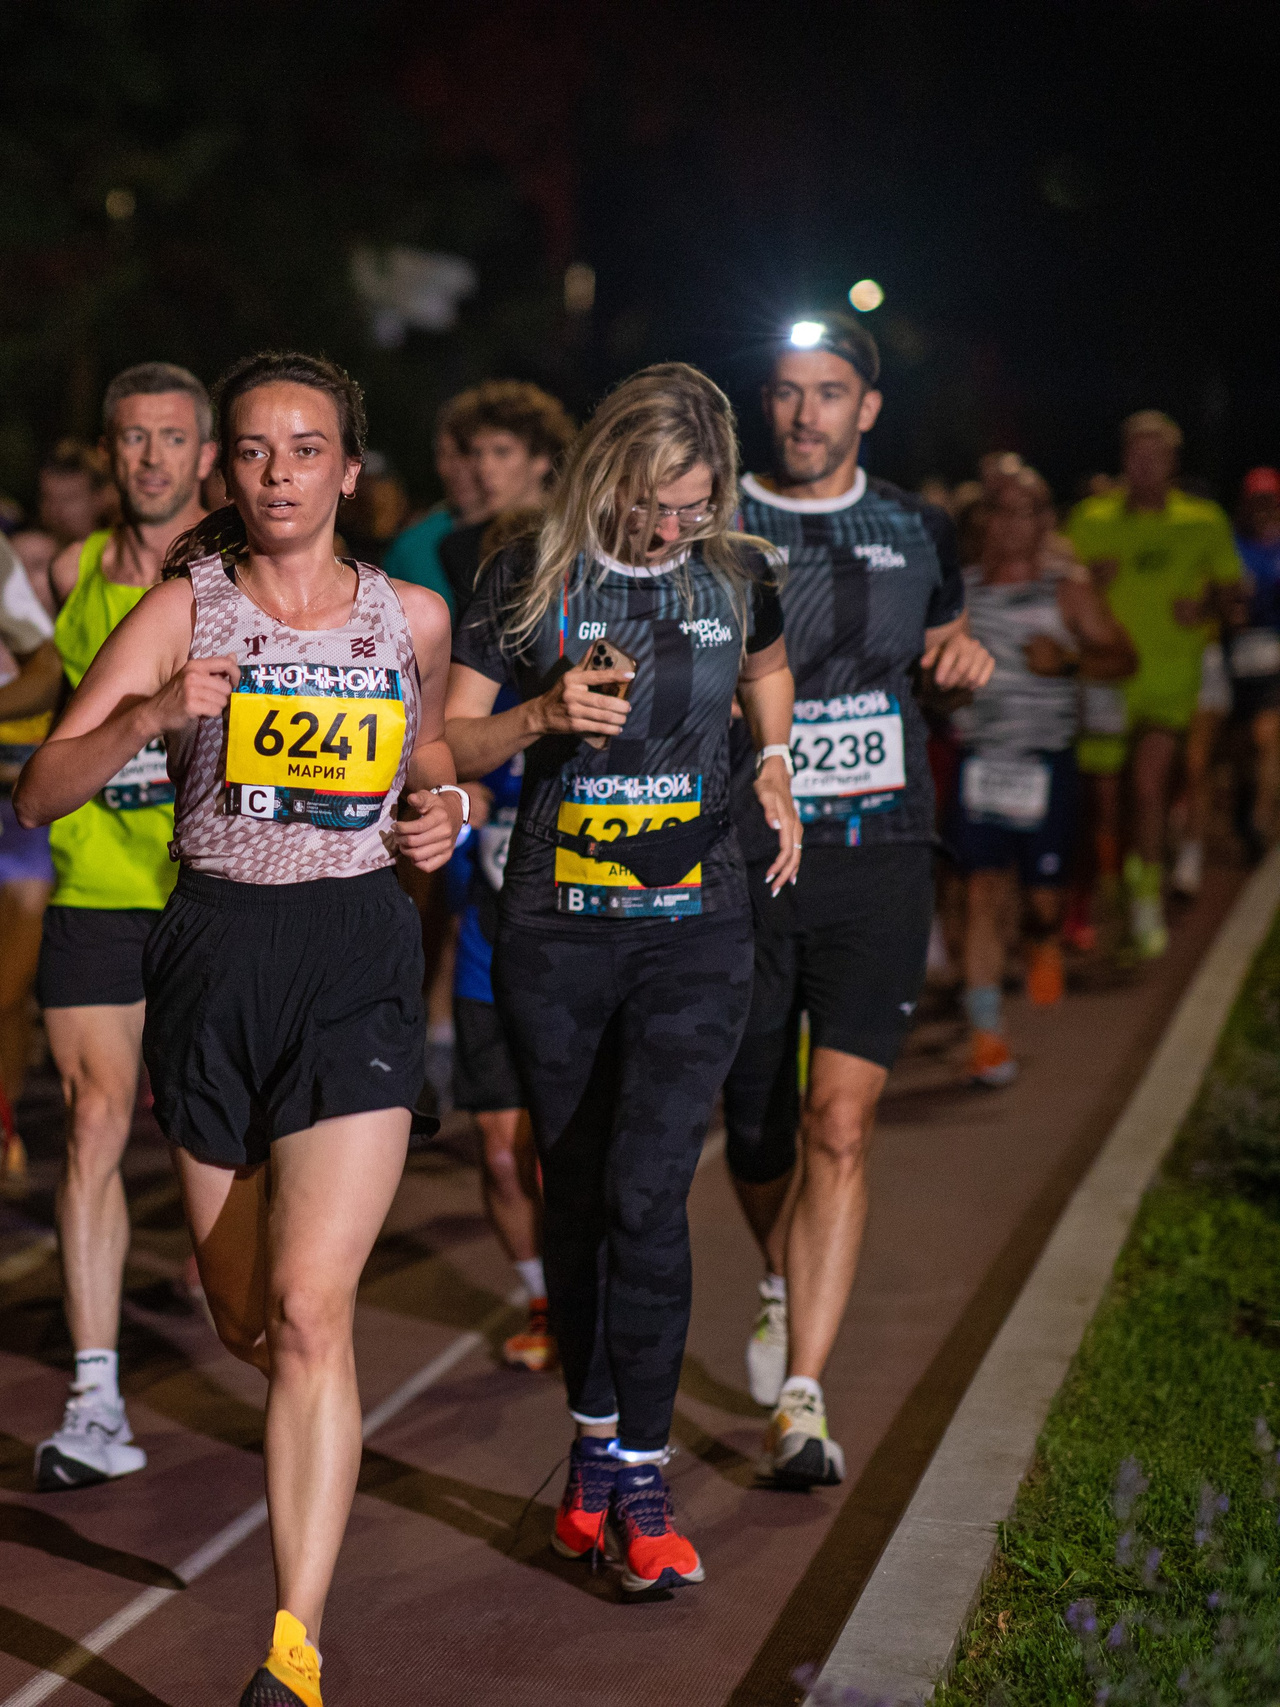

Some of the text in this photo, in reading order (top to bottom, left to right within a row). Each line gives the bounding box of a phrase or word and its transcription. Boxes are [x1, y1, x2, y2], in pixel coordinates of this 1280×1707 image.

[251, 664, 390, 692] НОЧНОЙ
[254, 709, 378, 762] 6241
[792, 730, 886, 771] 6238
[287, 763, 346, 780] МАРИЯ
[573, 773, 693, 798] НОЧНОЙ
[248, 790, 268, 814] C
[568, 888, 585, 911] B
